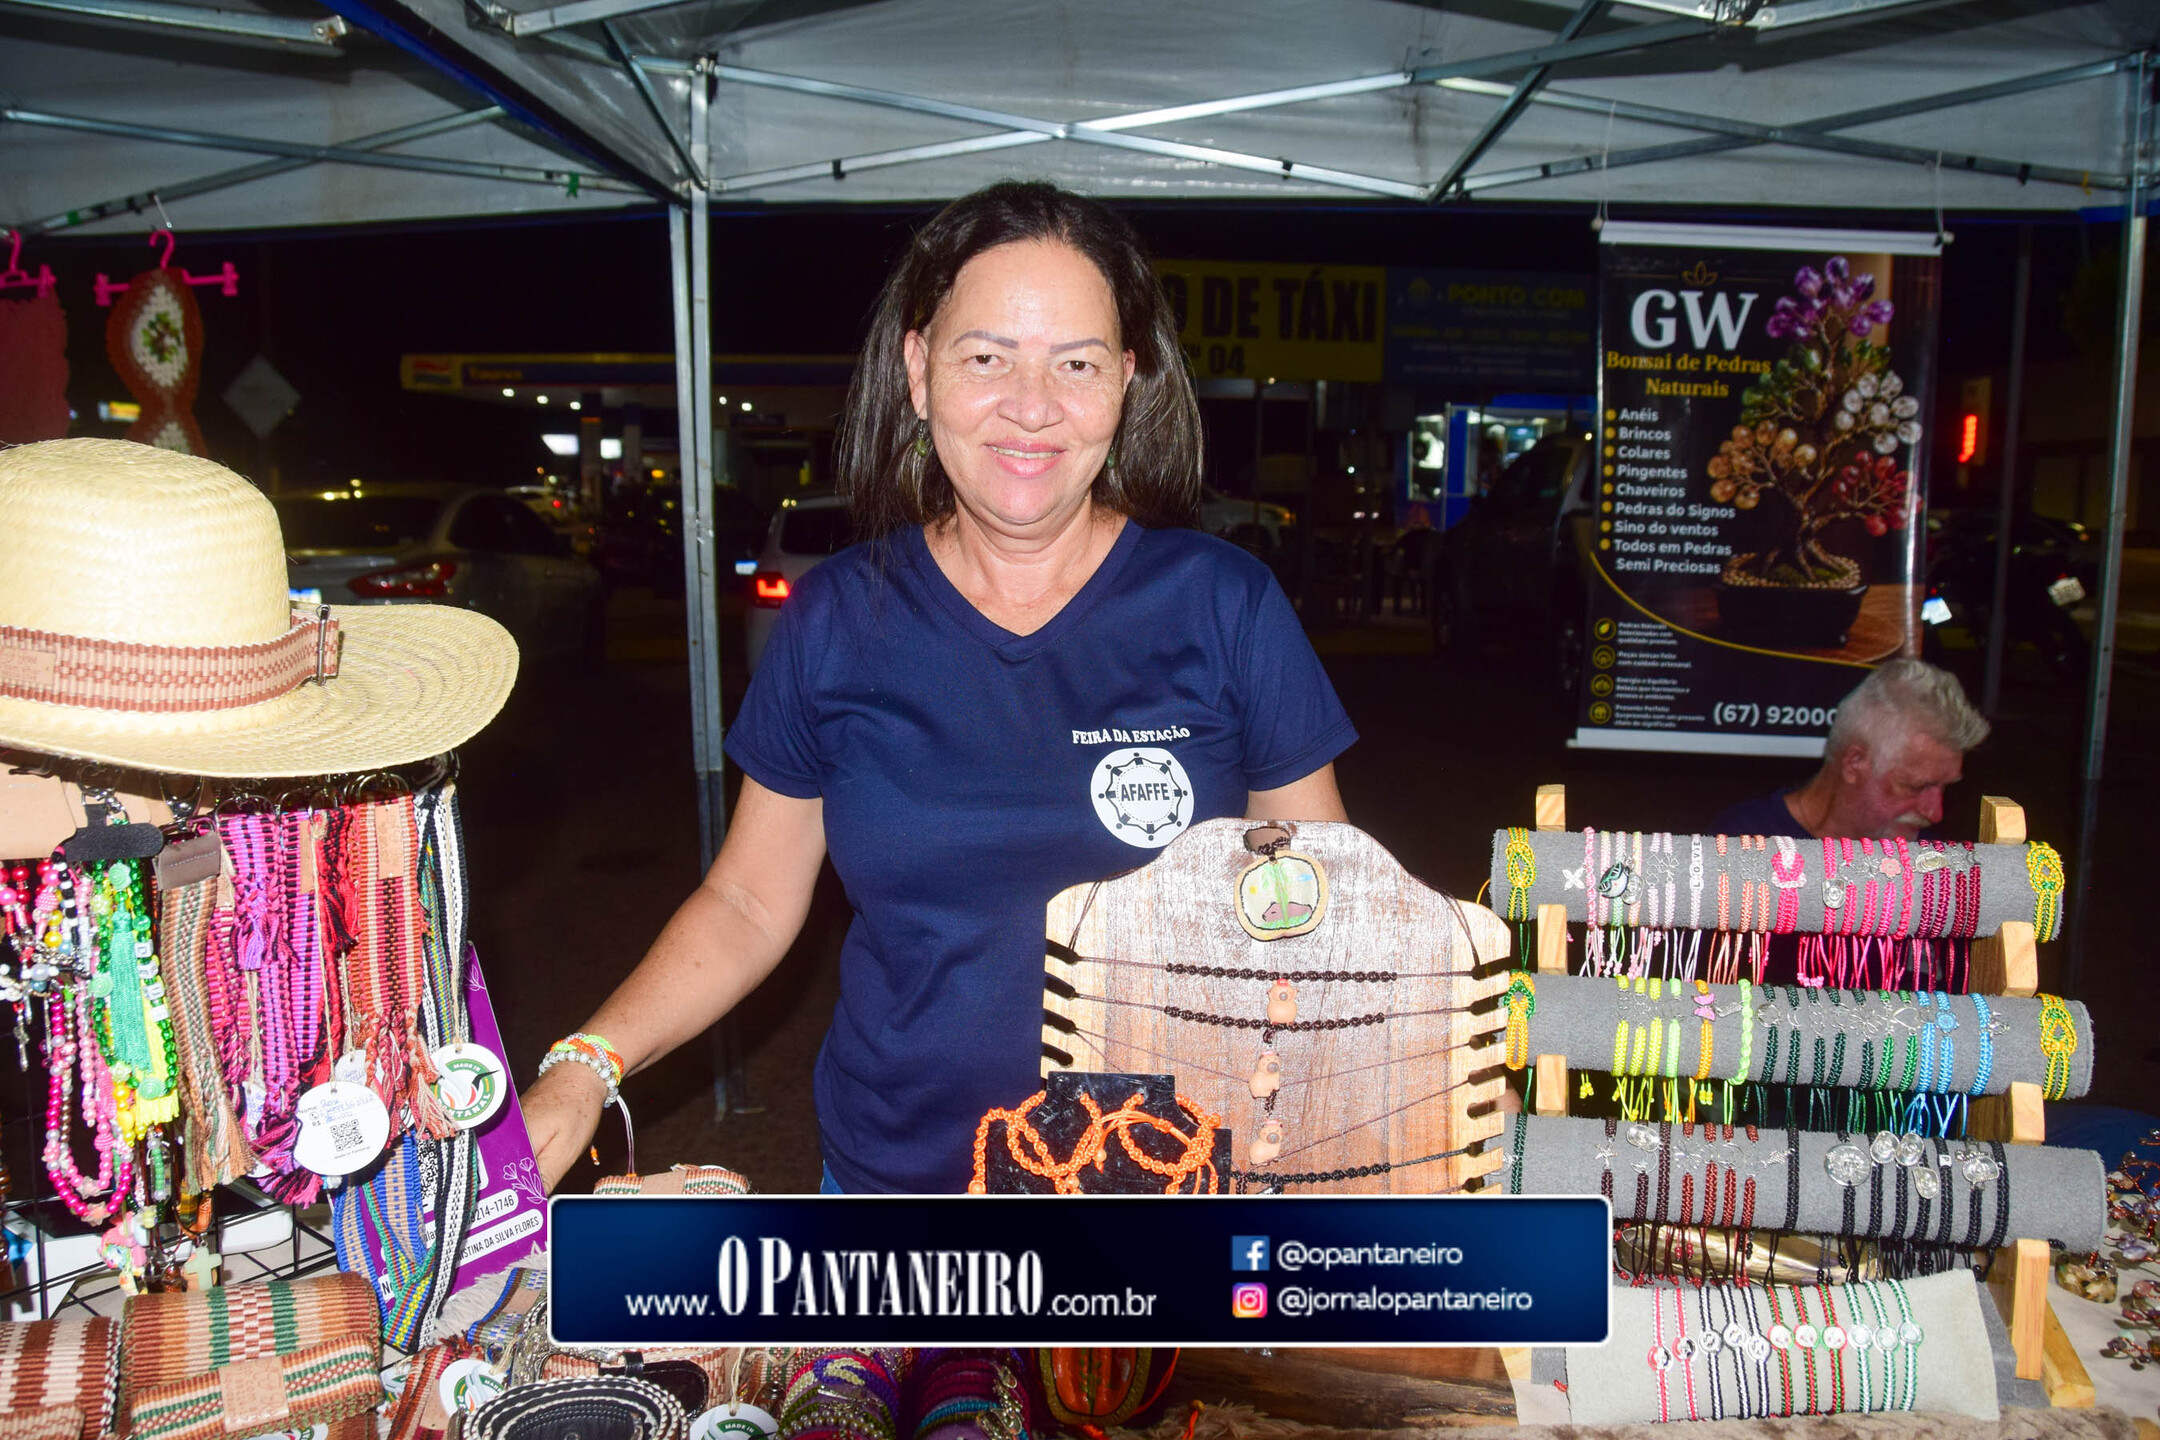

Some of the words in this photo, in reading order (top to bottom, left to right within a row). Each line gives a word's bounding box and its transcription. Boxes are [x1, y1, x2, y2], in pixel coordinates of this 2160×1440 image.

[1448, 284, 1526, 304] PONTO
[1202, 276, 1259, 338] DE
[1273, 268, 1377, 342] TÁXI
[1631, 289, 1759, 351] GW
[1209, 344, 1244, 375] 04
[1606, 351, 1672, 370] Bonsai
[1676, 354, 1701, 371] de
[1705, 354, 1772, 374] Pedras
[1646, 378, 1729, 397] Naturais
[1620, 407, 1659, 421] Anéis
[1619, 426, 1671, 440] Brincos
[1618, 445, 1671, 459] Colares
[1617, 464, 1688, 481] Pingentes
[1616, 483, 1686, 497] Chaveiros
[1615, 502, 1663, 515] Pedras
[1666, 503, 1686, 516] do
[1687, 504, 1736, 520] Signos
[1614, 520, 1646, 533] Sino
[1648, 521, 1667, 534] do
[1670, 524, 1719, 536] ventos
[1614, 539, 1656, 552] Todos
[1659, 543, 1680, 552] em
[1684, 542, 1732, 555] Pedras
[1616, 558, 1651, 571] Semi
[1653, 559, 1721, 573] Preciosas
[1714, 701, 1760, 727] (67)
[1072, 728, 1112, 744] FEIRA
[1112, 729, 1132, 742] DA
[1132, 725, 1190, 742] ESTAÇÃO
[1121, 783, 1170, 801] AFAFFE
[470, 1195, 515, 1224] 9214-1746
[484, 1236, 494, 1249] DA
[495, 1226, 515, 1244] SILVA
[514, 1216, 540, 1235] FLORES
